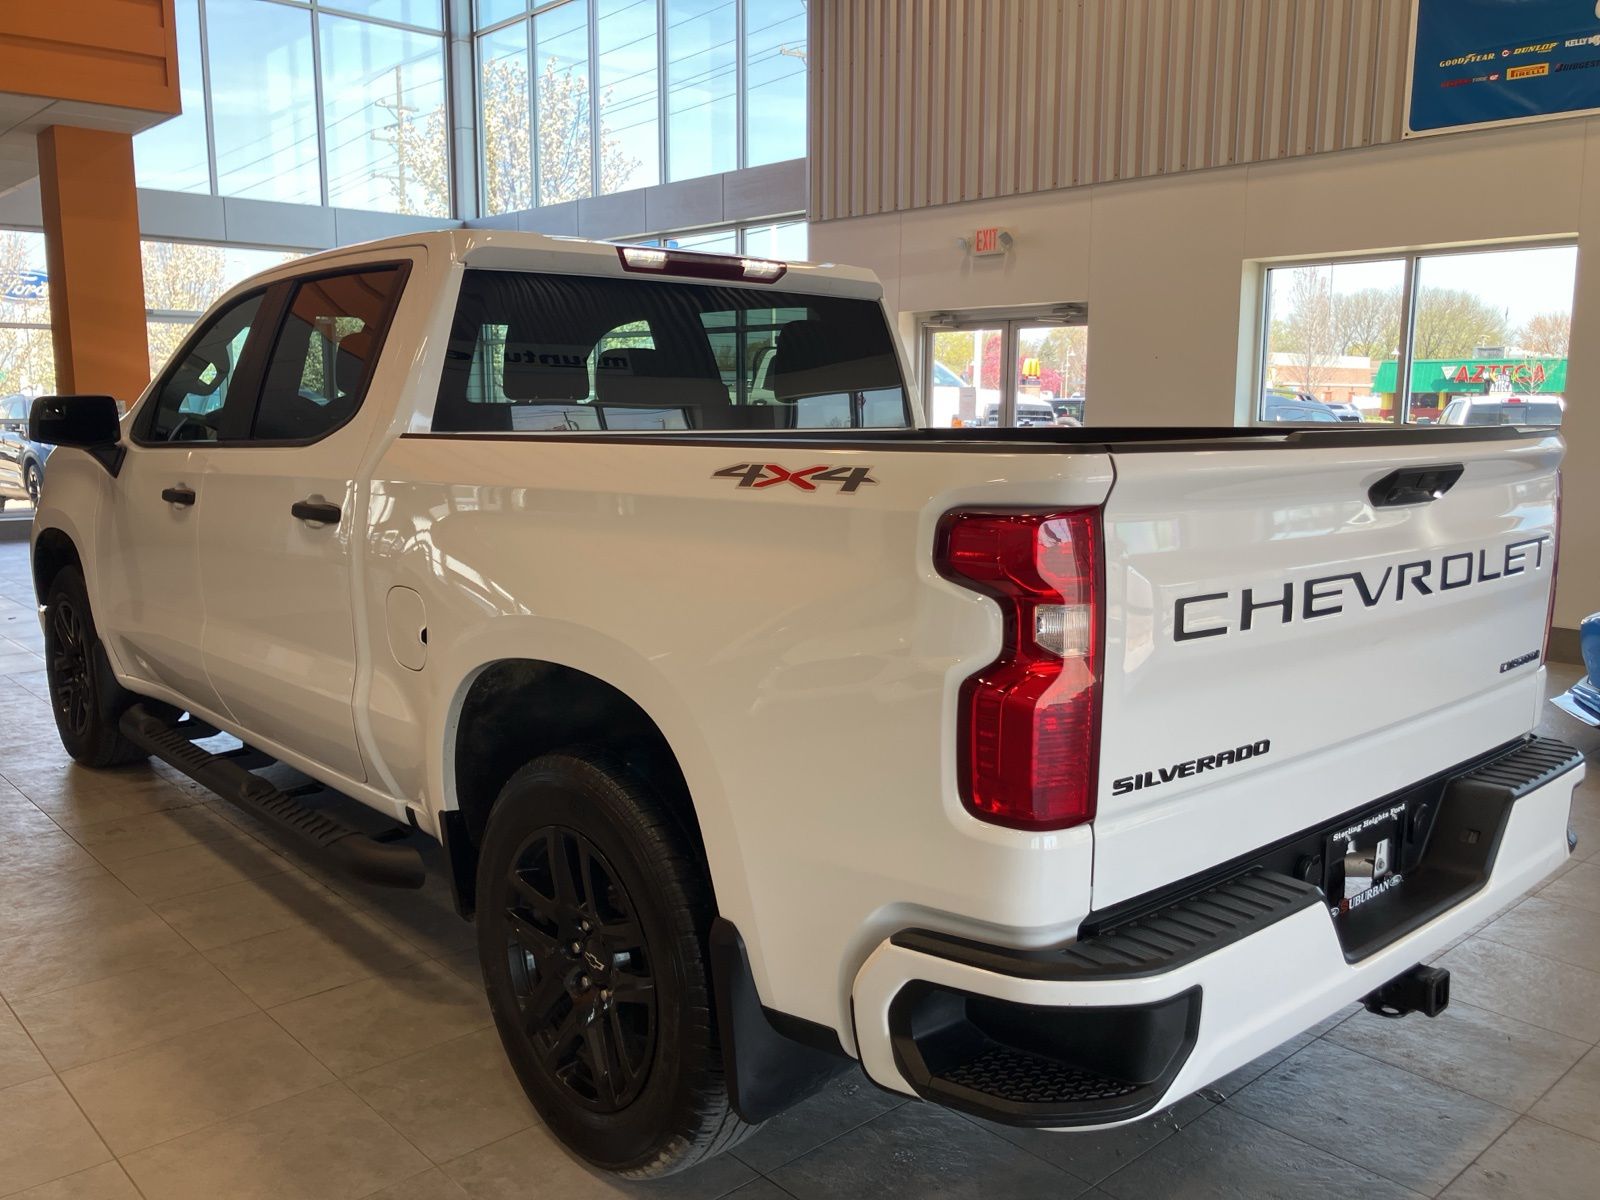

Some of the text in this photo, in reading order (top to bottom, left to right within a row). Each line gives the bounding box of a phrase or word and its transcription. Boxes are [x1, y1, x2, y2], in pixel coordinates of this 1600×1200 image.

[1439, 53, 1495, 68] GOODYEAR
[1513, 42, 1559, 55] DUNLOP
[1510, 65, 1546, 78] PIRELLI
[975, 228, 998, 252] EXIT
[1173, 535, 1549, 642] CHEVROLET
[1112, 738, 1271, 796] SILVERADO
[1332, 803, 1405, 842] Sterling Heights Ford
